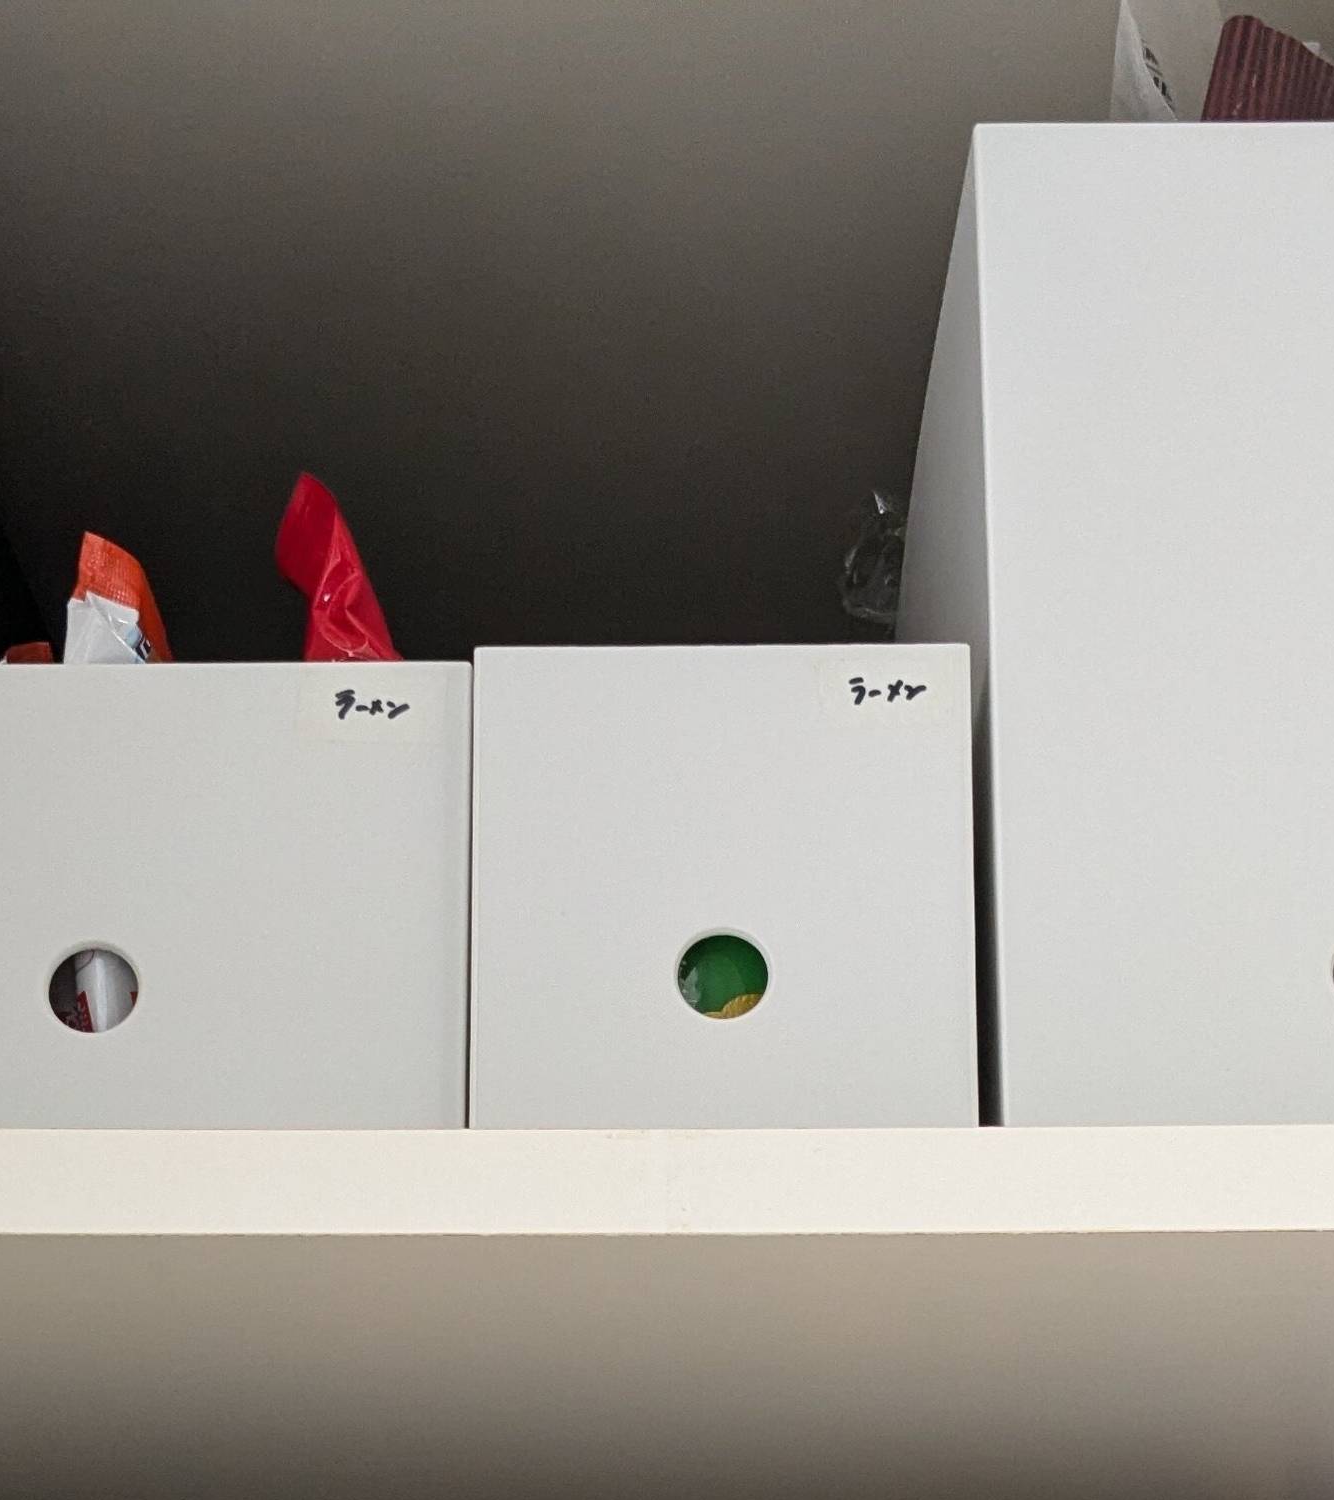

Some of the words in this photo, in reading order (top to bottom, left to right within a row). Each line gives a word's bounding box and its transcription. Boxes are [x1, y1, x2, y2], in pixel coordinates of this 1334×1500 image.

[335, 689, 410, 720] ラーメン
[848, 676, 927, 706] ラーメン
